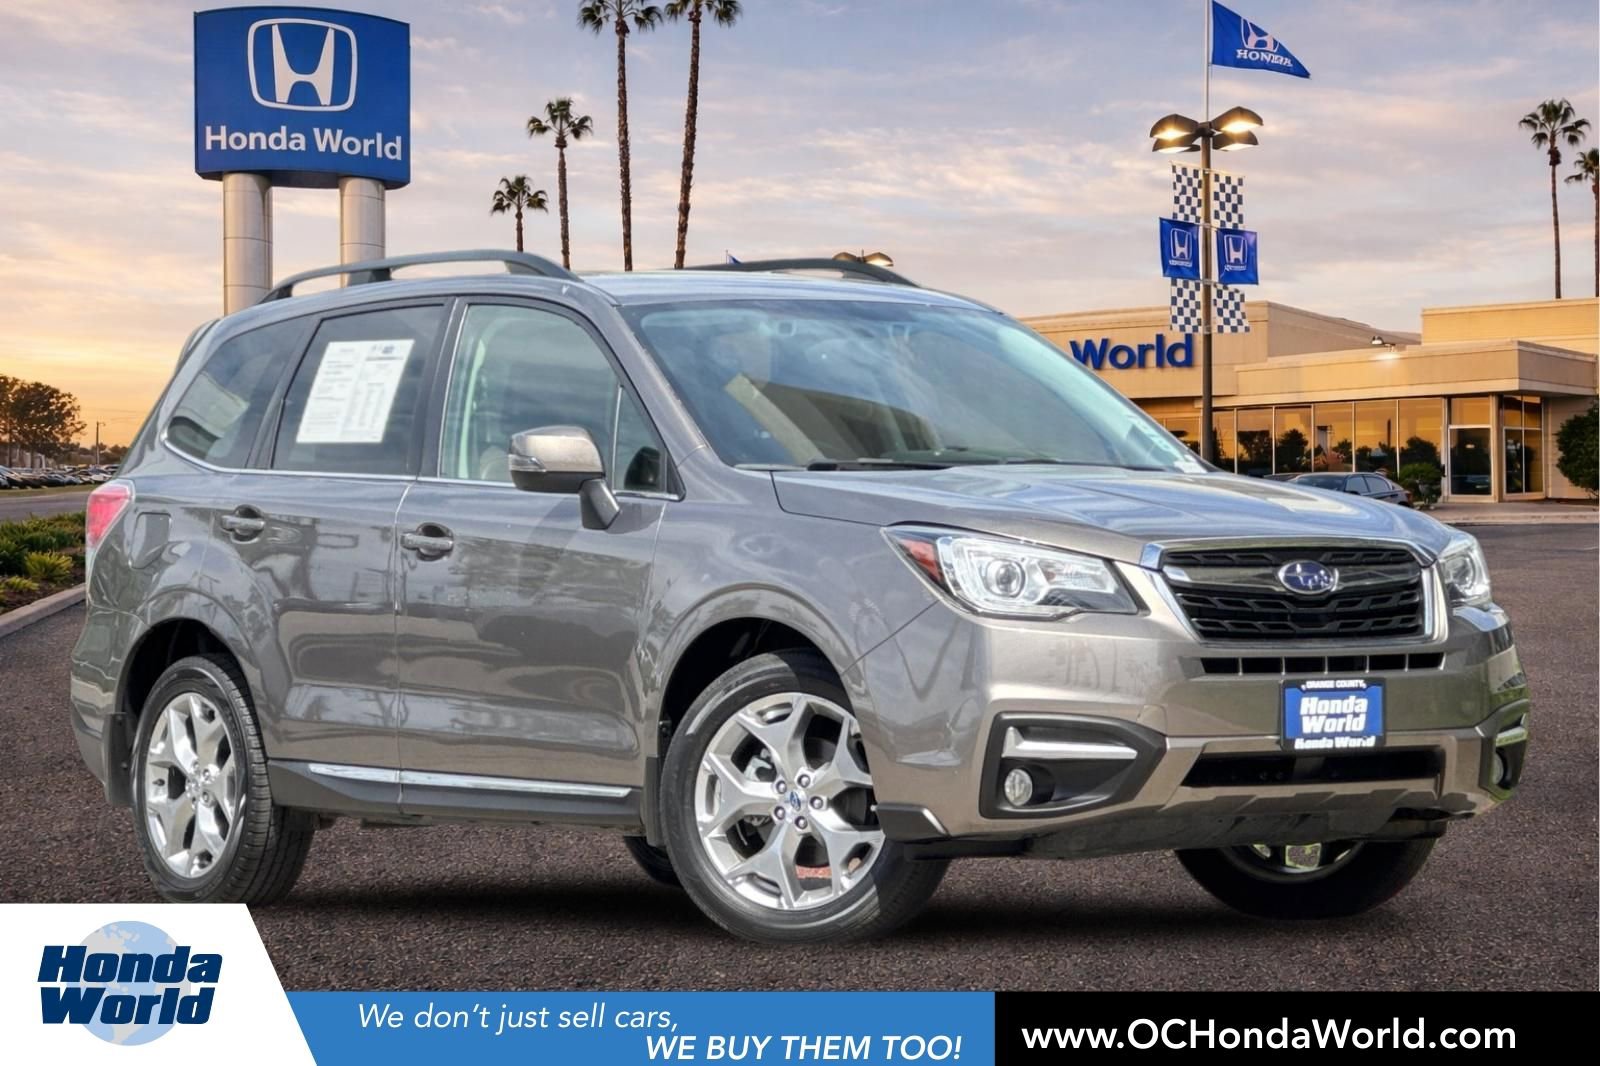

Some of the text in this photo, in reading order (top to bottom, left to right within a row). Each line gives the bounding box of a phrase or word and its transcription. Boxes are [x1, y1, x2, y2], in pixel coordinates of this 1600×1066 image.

[205, 125, 402, 160] Honda World
[1069, 333, 1193, 370] World
[1300, 695, 1368, 715] Honda
[1302, 713, 1366, 733] World
